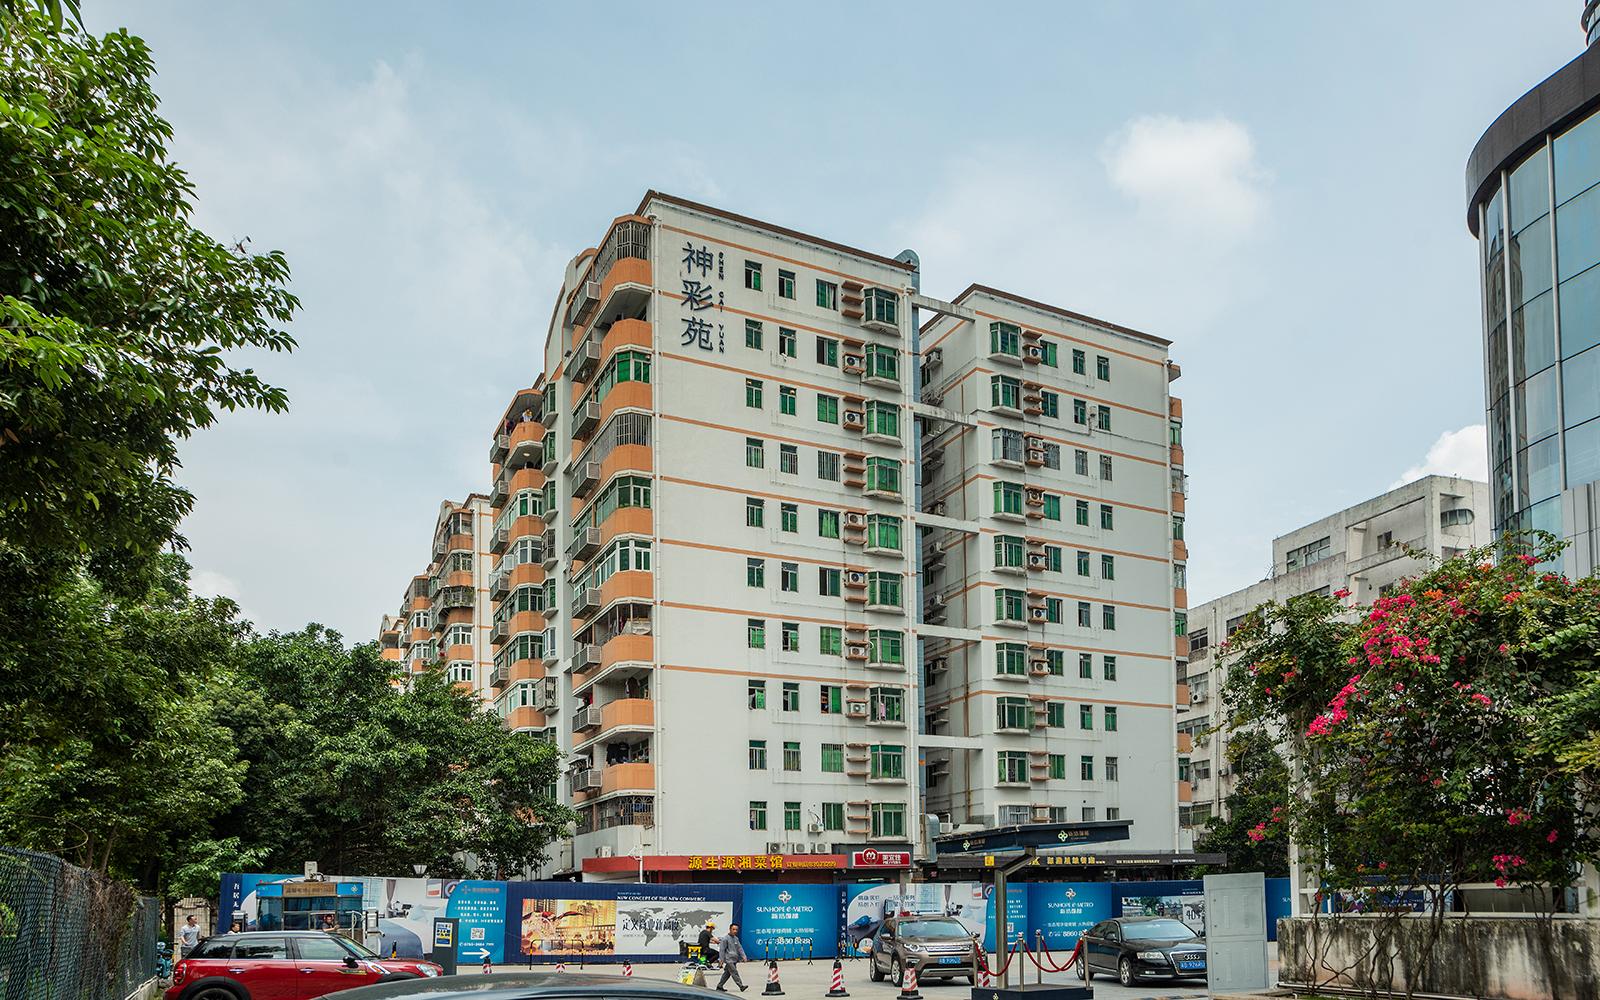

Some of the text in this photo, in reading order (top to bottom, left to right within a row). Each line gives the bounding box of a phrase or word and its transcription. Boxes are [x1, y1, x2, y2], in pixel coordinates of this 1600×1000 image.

[681, 241, 714, 351] 神彩苑
[688, 856, 784, 870] 源生源湘菜馆
